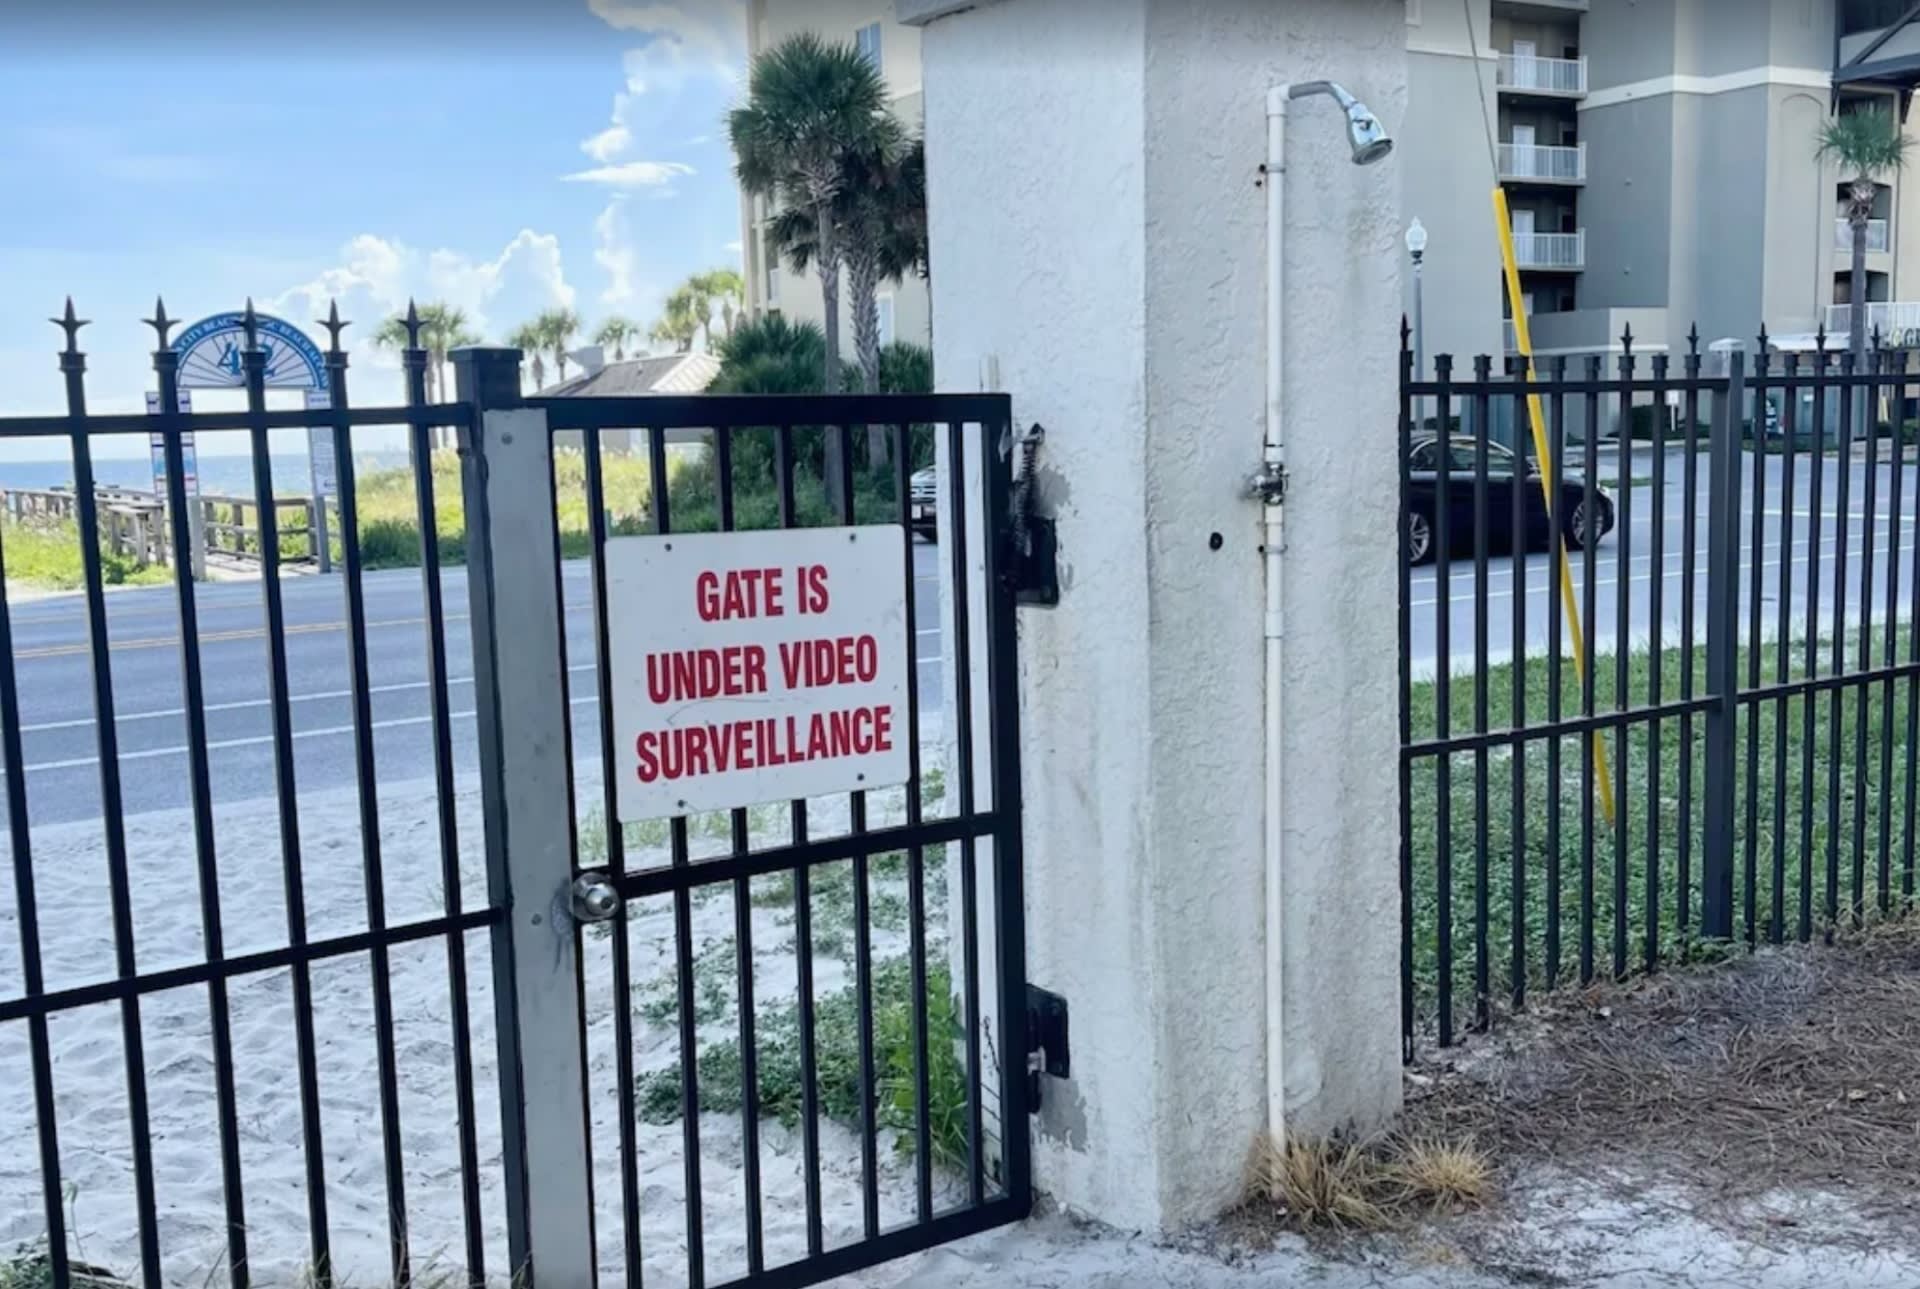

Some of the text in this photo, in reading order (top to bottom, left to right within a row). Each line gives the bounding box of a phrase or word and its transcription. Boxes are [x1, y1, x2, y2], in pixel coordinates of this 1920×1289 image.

[202, 316, 236, 333] BEAC
[696, 565, 829, 622] GATE IS
[647, 635, 878, 704] UNDER VIDEO
[636, 705, 892, 783] SURVEILLANCE
